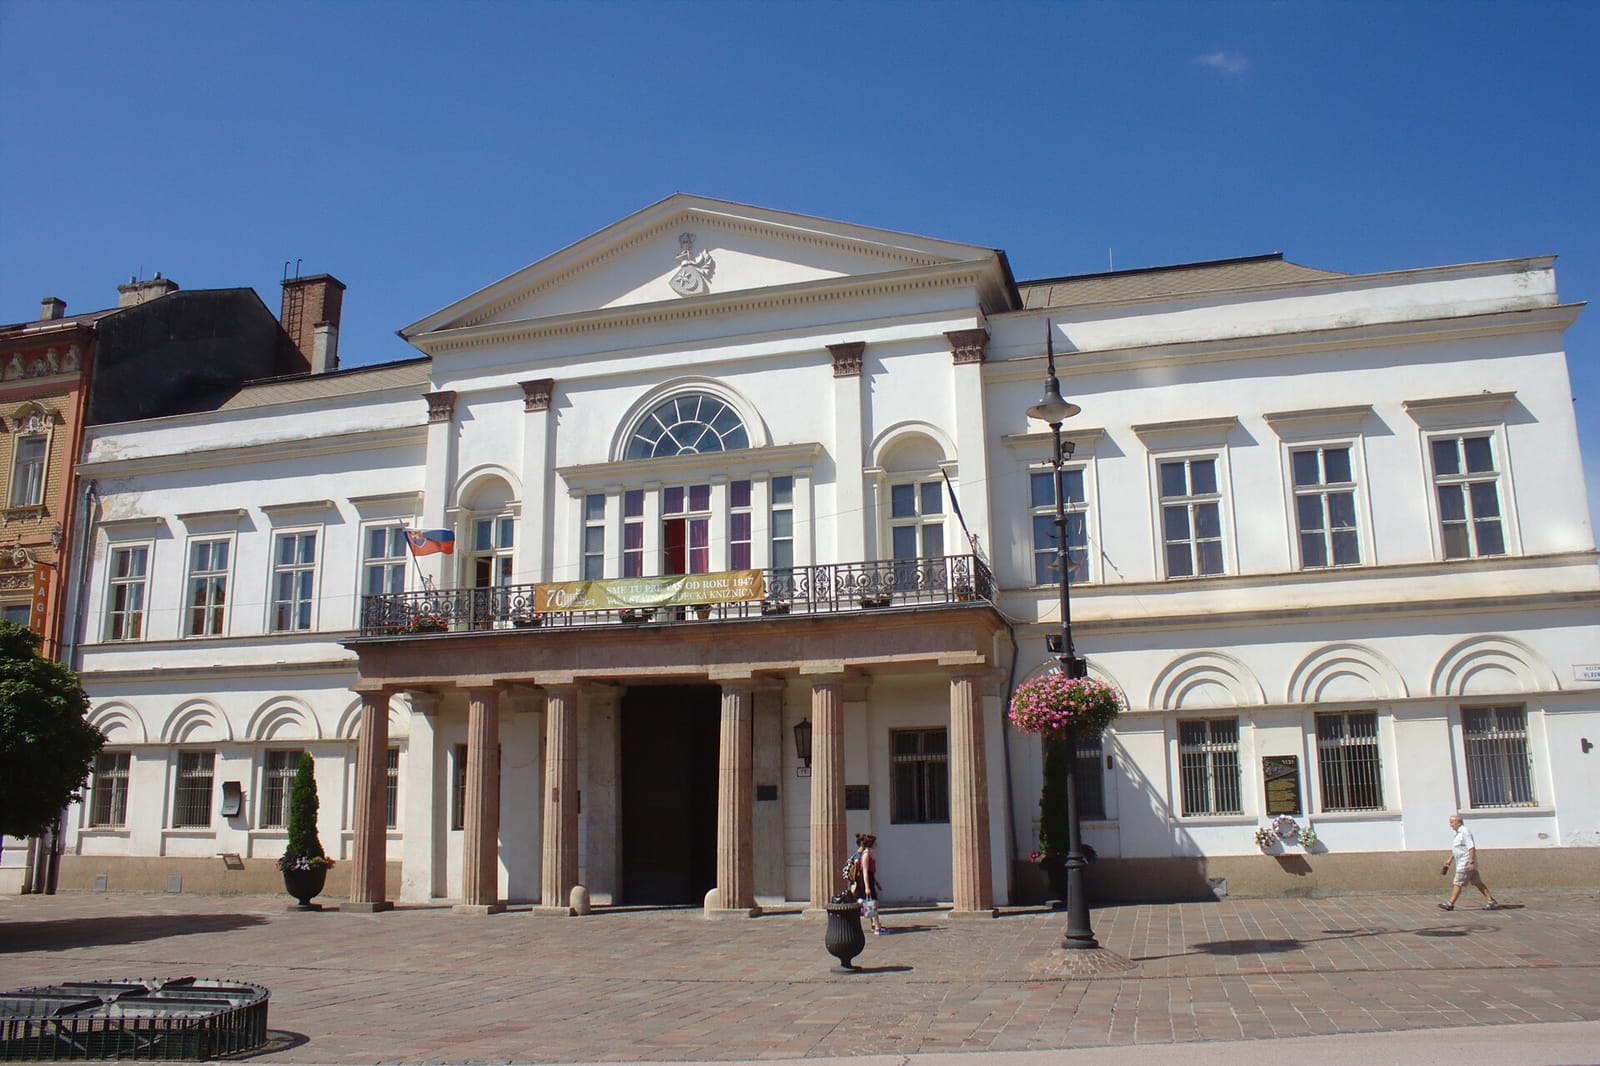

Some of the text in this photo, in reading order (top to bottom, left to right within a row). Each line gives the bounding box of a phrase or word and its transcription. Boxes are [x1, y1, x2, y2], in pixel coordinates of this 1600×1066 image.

[685, 581, 700, 590] OD
[703, 579, 730, 589] ROKU
[733, 576, 754, 587] 1947
[546, 589, 566, 608] 70
[709, 588, 754, 600] KNIŽNICA
